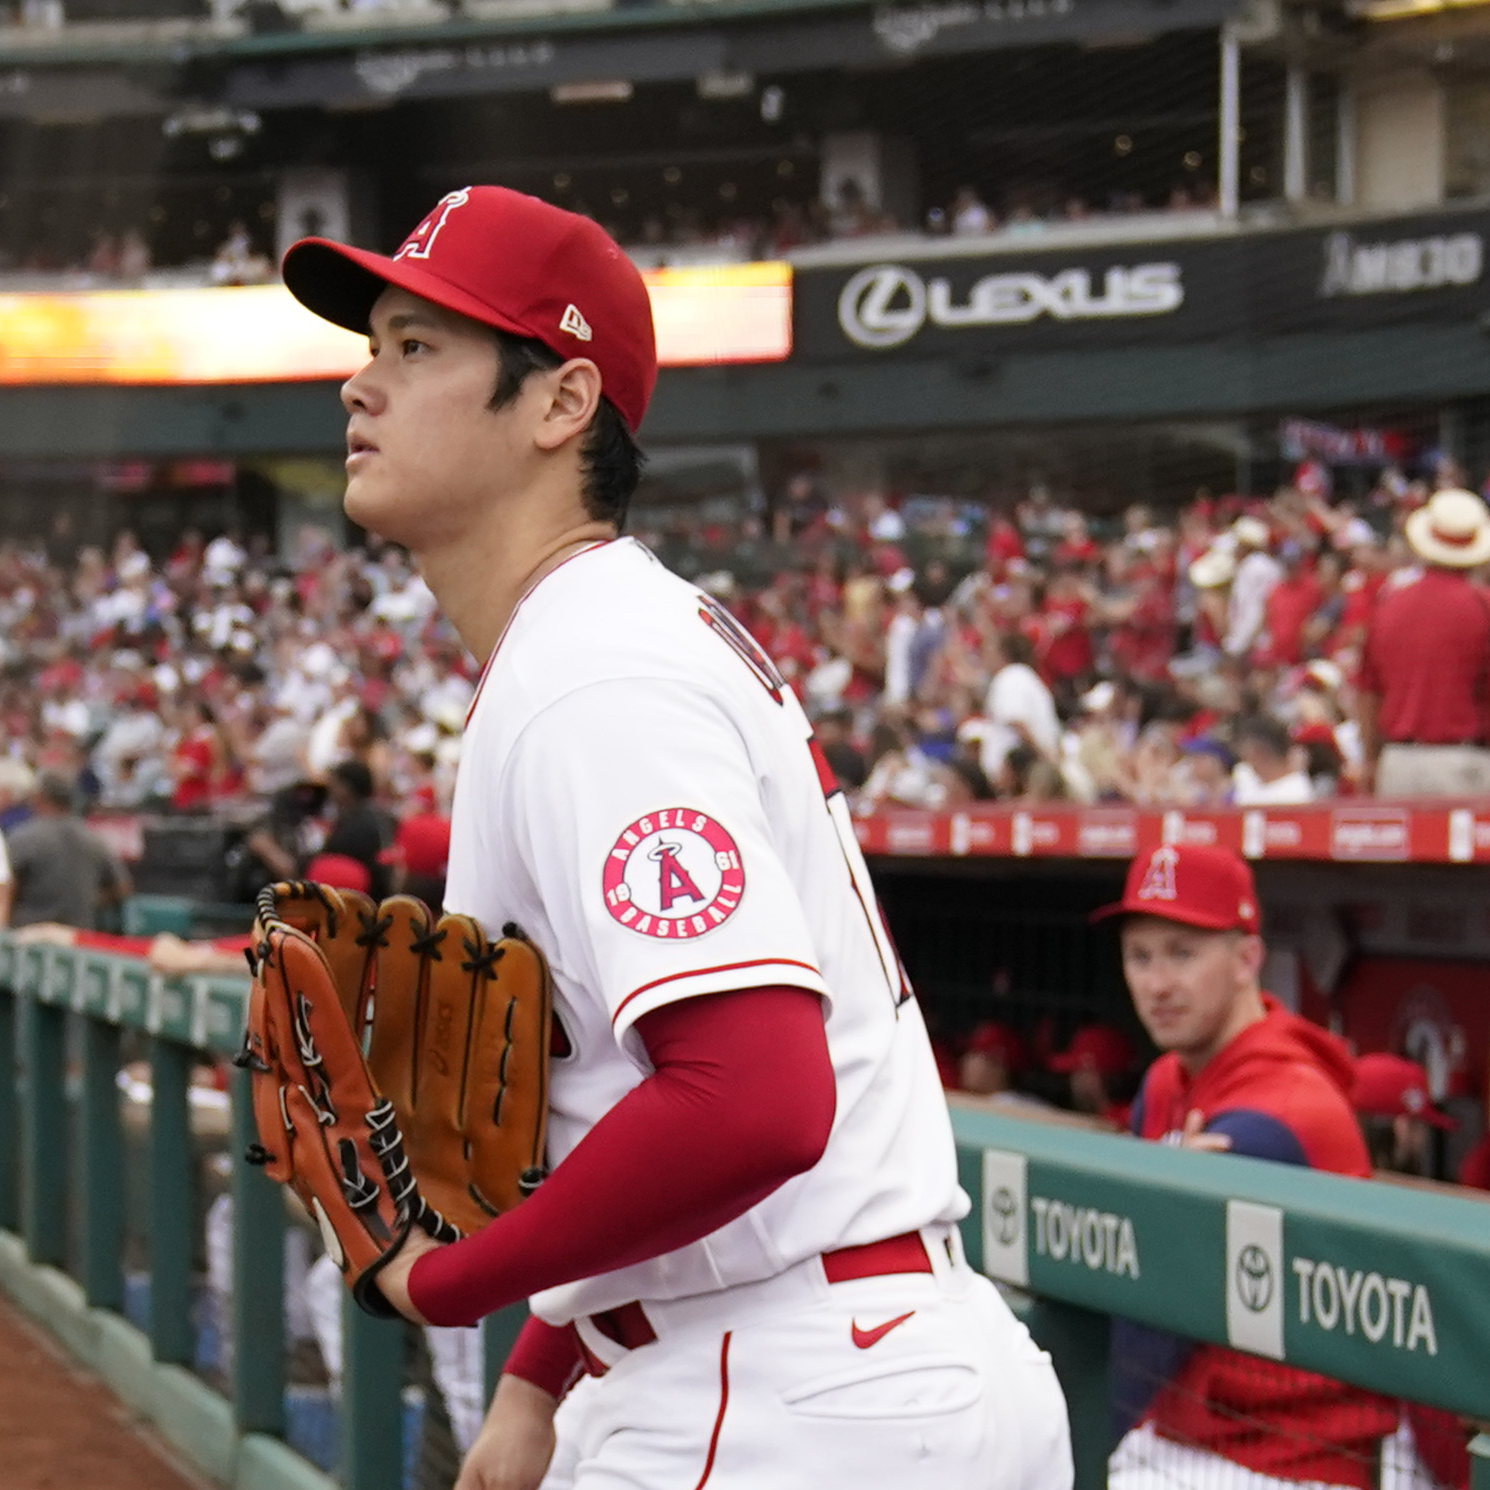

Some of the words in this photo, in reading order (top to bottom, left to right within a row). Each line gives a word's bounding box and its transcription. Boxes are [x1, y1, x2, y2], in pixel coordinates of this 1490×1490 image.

[927, 261, 1185, 328] LEXUS
[611, 809, 708, 862] ANGELS
[620, 884, 742, 937] BASEBALL
[1030, 1197, 1141, 1281] TOYOTA
[1291, 1256, 1438, 1357] TOYOTA
